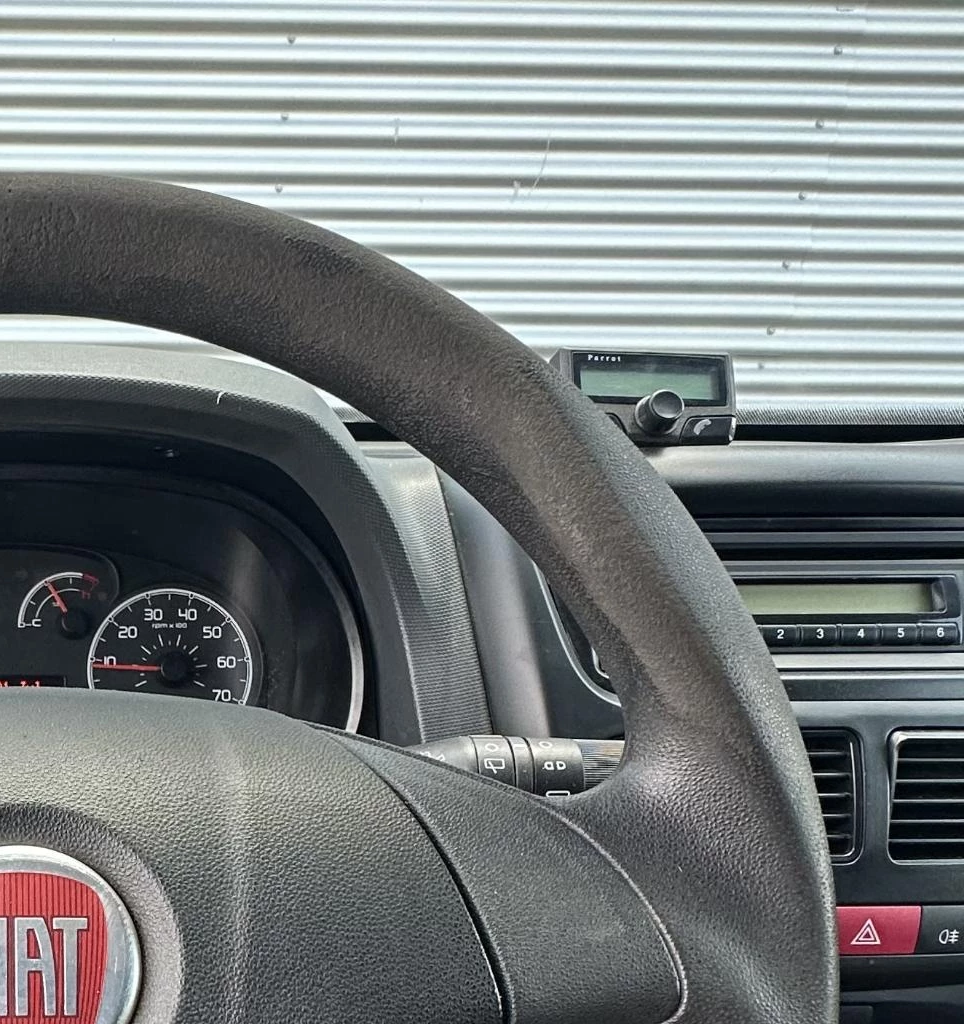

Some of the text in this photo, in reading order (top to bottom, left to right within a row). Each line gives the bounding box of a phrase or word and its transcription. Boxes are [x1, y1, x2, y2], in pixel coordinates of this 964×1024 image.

[588, 354, 621, 362] Parrot
[144, 609, 163, 621] 30
[178, 609, 197, 621] 40
[31, 618, 41, 627] C
[118, 626, 137, 638] 20
[203, 626, 222, 638] 50
[777, 629, 785, 639] 2
[816, 628, 824, 638] 3
[857, 628, 865, 638] 4
[897, 627, 905, 638] 5
[936, 627, 944, 638] 6
[217, 656, 236, 668] 60
[213, 689, 232, 701] 70
